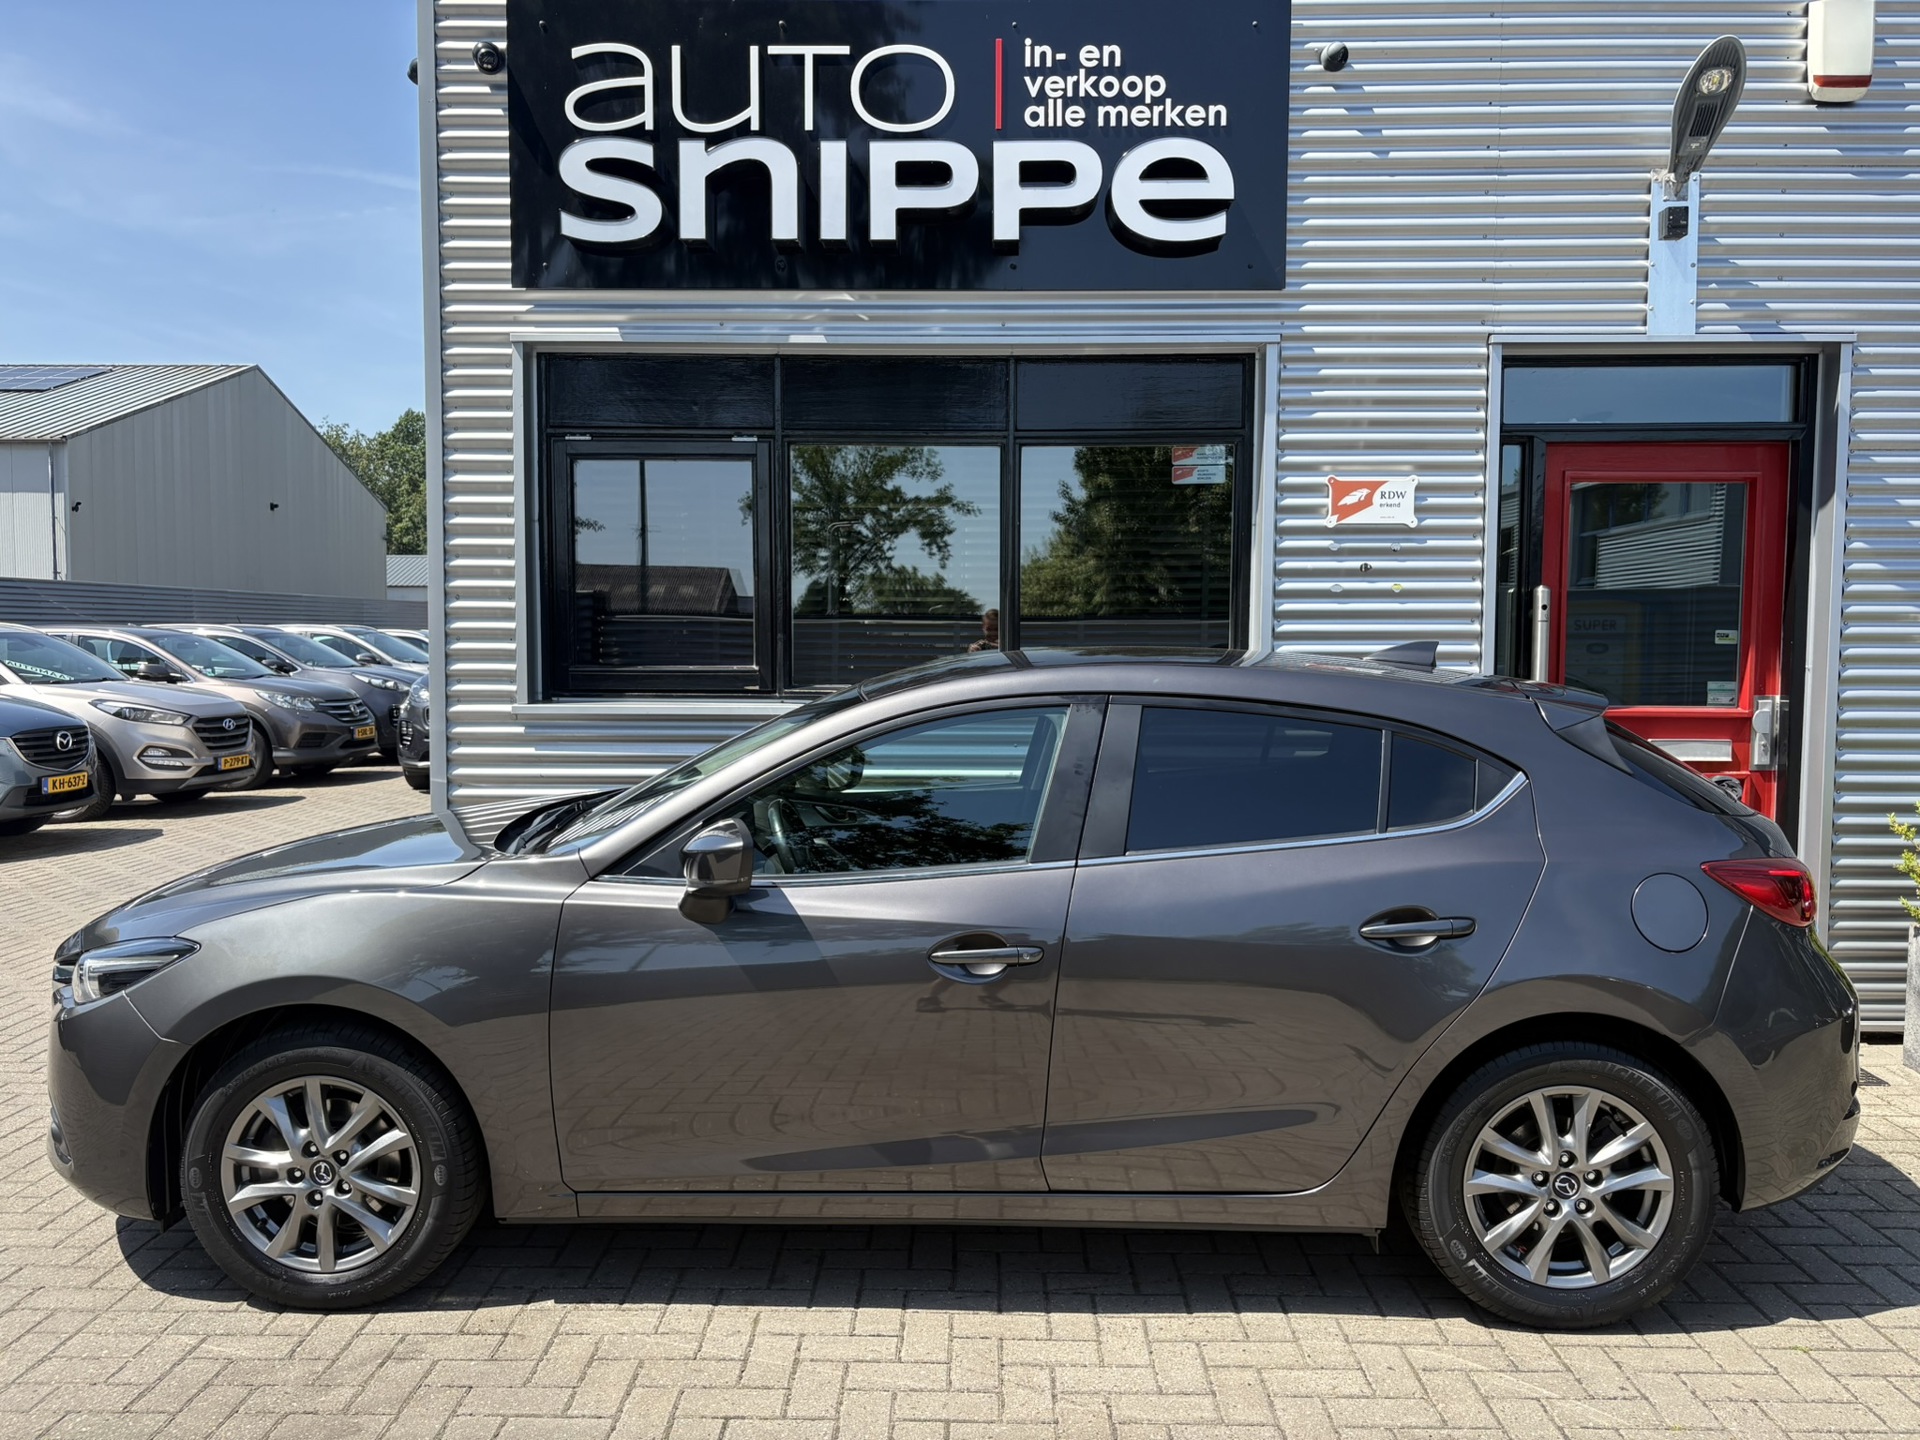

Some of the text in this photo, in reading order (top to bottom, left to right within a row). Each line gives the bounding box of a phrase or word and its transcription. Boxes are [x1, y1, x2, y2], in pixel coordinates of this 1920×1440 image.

[1024, 37, 1122, 68] in- en
[1023, 68, 1167, 104] verkoop
[1023, 98, 1228, 127] alle merken
[1380, 490, 1407, 500] RDW
[1574, 619, 1617, 631] SUPER
[52, 774, 86, 791] KH-637-Z
